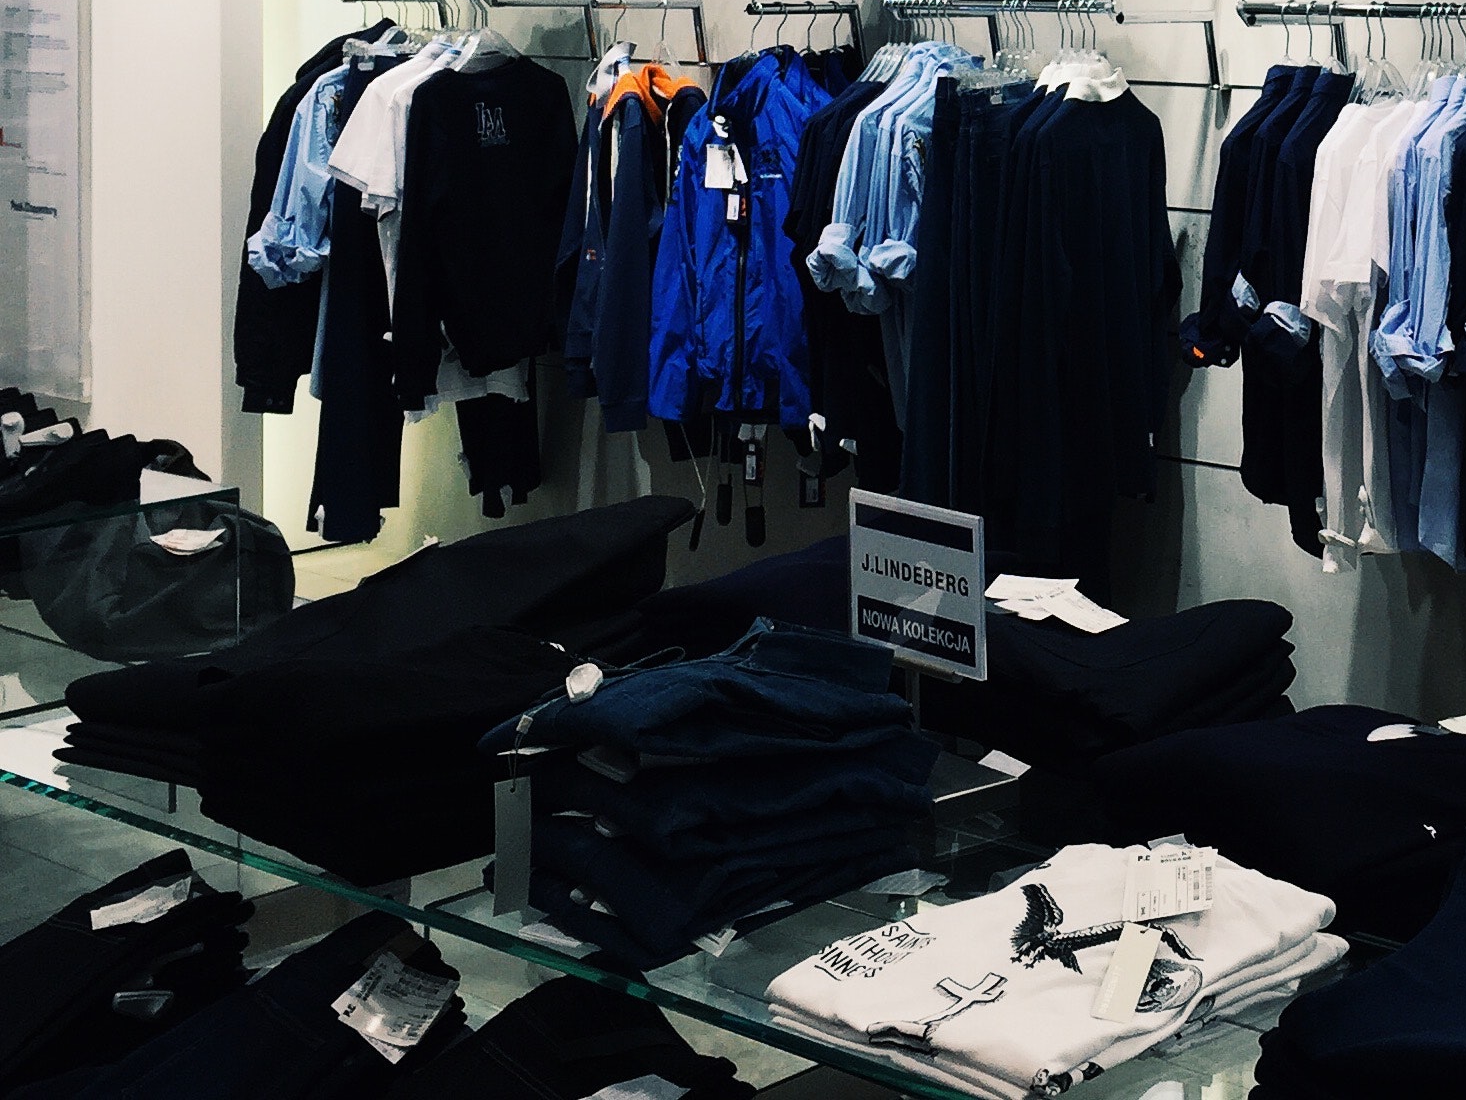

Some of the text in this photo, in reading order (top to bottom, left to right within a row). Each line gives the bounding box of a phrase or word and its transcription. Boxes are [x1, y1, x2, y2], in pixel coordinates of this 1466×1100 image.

[861, 553, 969, 597] J.LINDEBERG
[862, 608, 971, 654] NOWA KOLEKCJA
